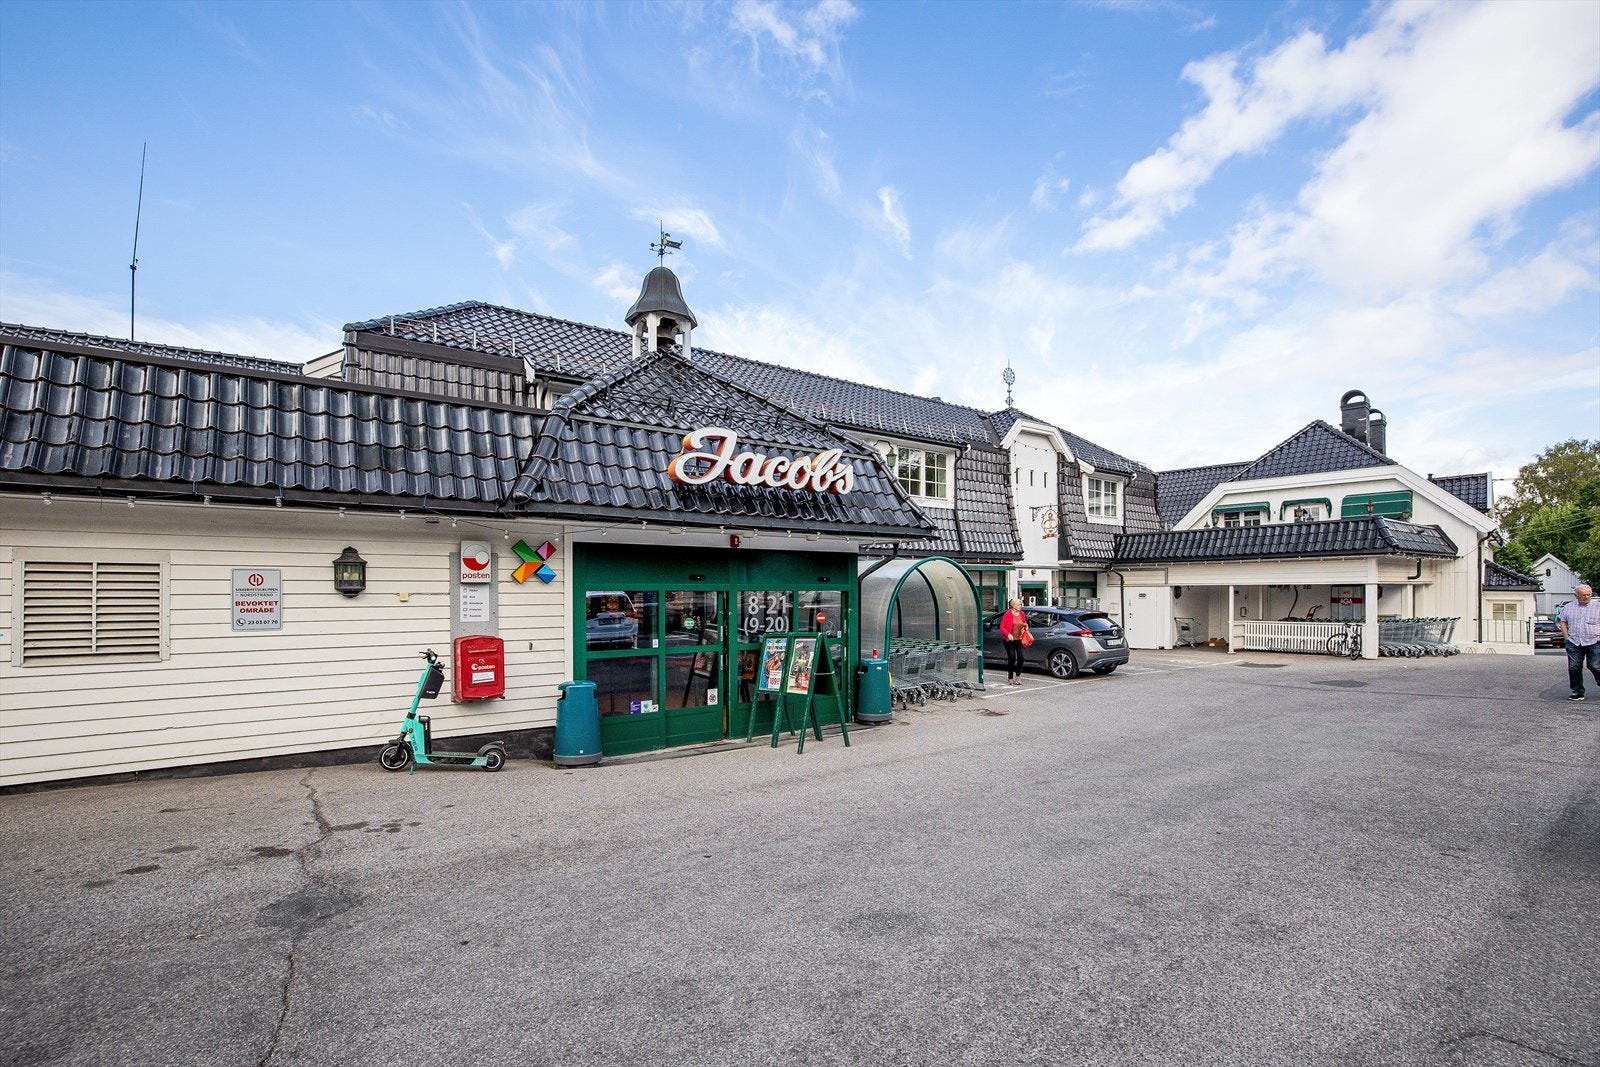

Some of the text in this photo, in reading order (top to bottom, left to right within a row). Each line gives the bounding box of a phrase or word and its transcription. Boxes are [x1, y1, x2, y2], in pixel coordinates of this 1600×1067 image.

[462, 572, 490, 580] posten
[748, 595, 787, 615] 8-21
[744, 615, 790, 636] (9-20)
